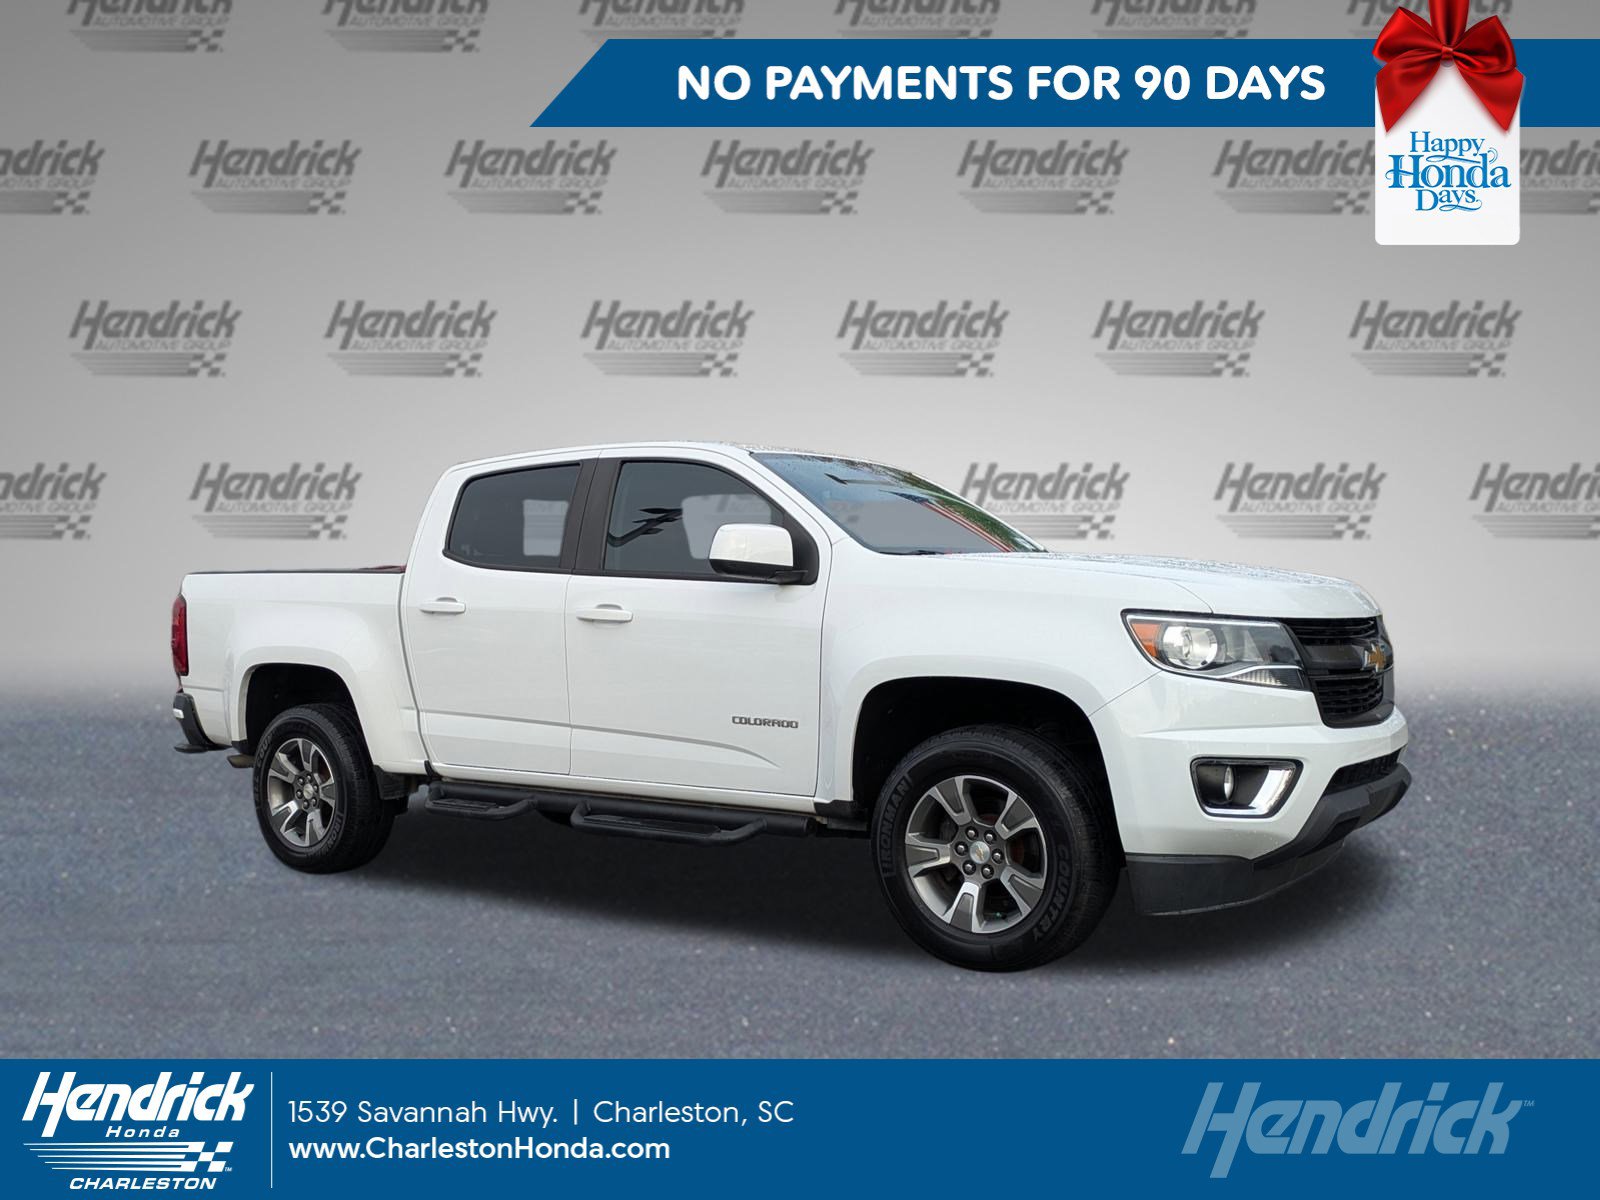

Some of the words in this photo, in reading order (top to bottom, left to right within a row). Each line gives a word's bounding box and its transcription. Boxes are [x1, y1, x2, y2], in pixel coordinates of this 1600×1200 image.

[0, 137, 106, 176] ndrick
[189, 137, 362, 188] Hendrick
[445, 137, 618, 188] Hendrick
[701, 137, 874, 188] Hendrick
[957, 137, 1130, 188] Hendrick
[69, 299, 242, 350] Hendrick
[325, 299, 498, 350] Hendrick
[581, 299, 754, 350] Hendrick
[837, 299, 1010, 350] Hendrick
[1093, 299, 1266, 350] Hendrick
[1349, 299, 1522, 350] Hendrick
[0, 461, 107, 500] ndrick
[190, 461, 363, 512] Hendrick
[959, 462, 1131, 507] Hendrick
[1214, 461, 1387, 512] Hendrick
[1470, 462, 1600, 512] Hendri
[731, 715, 799, 729] COLORADO
[880, 777, 911, 870] IRONMAN
[1032, 844, 1070, 942] COUNTRY
